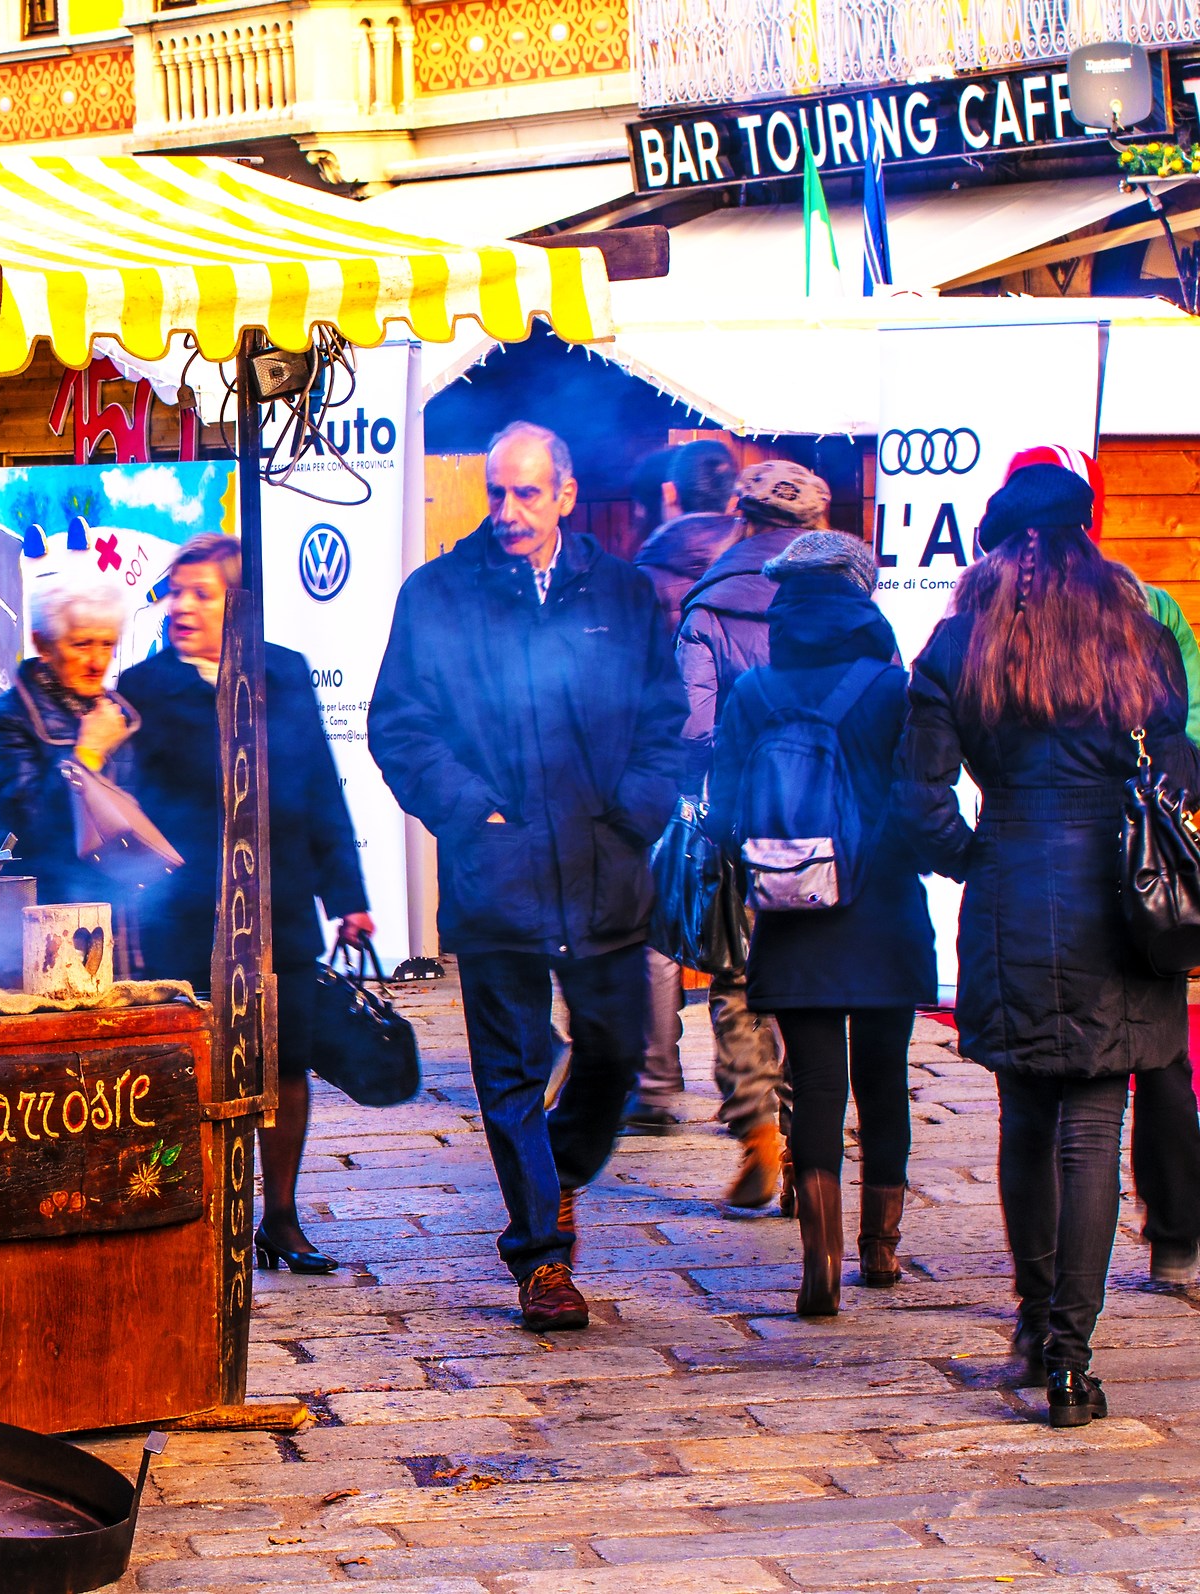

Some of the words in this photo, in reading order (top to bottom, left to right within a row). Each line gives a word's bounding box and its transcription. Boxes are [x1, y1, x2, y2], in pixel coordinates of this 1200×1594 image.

[639, 121, 724, 188] BAR
[737, 87, 938, 176] TOURING
[958, 72, 1108, 149] CAFF
[356, 459, 395, 470] PROVINCIA
[903, 578, 916, 590] di
[310, 669, 343, 688] OMO
[326, 704, 337, 714] per
[338, 702, 356, 711] Lecco
[329, 715, 348, 726] Como
